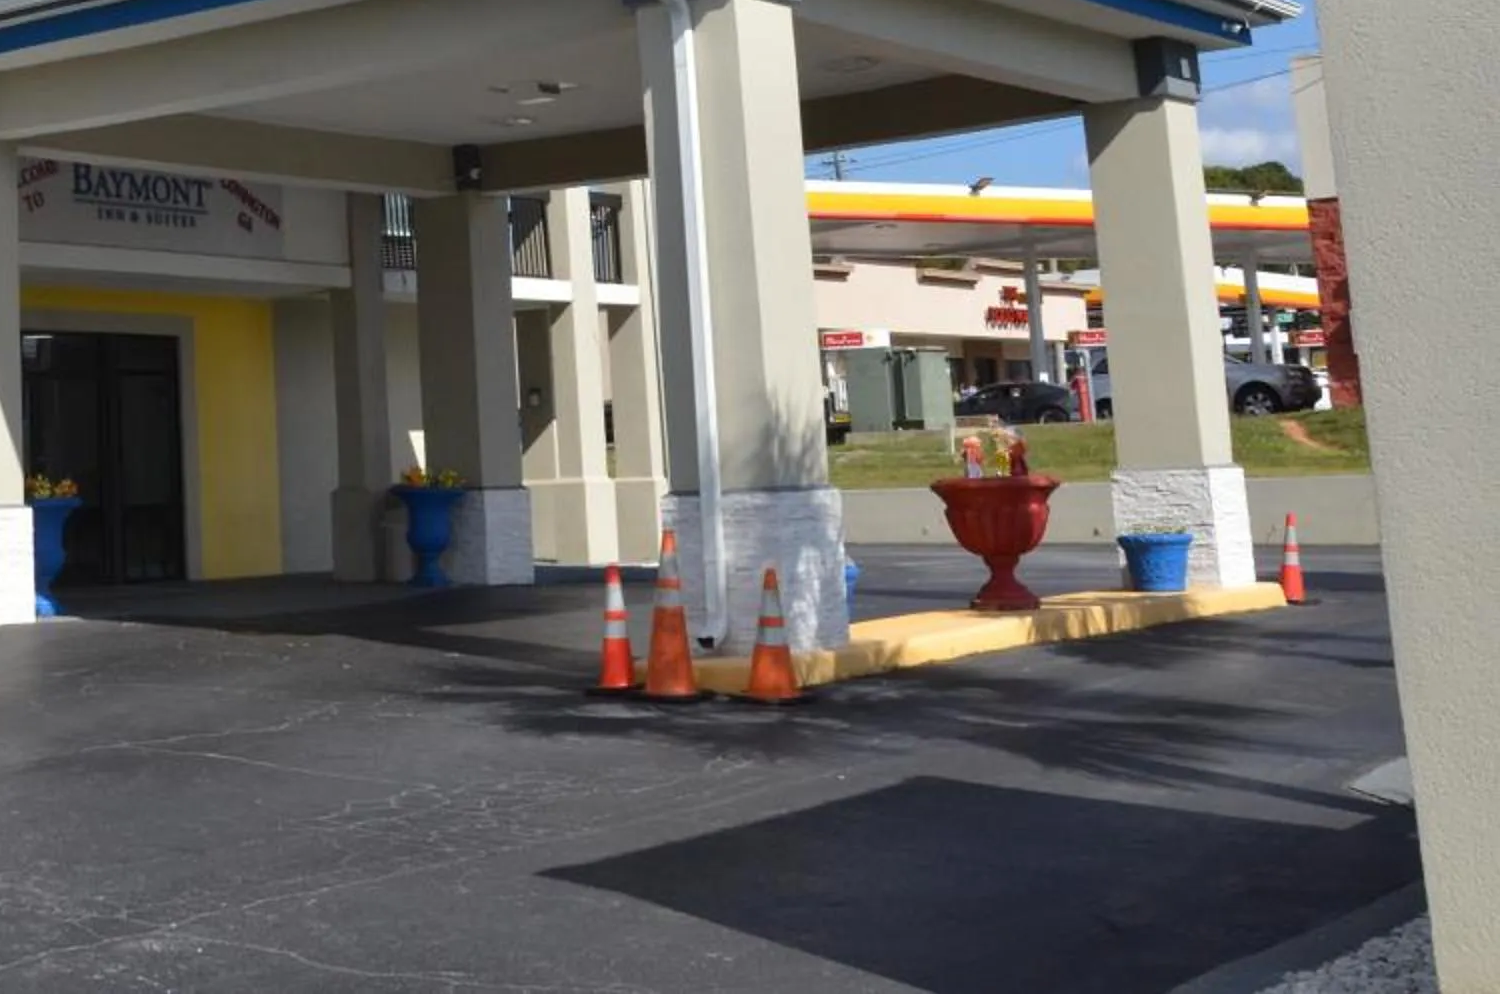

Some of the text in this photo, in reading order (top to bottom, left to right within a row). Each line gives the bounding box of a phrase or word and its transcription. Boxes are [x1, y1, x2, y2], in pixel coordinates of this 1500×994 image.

[72, 162, 210, 208] BAYMONT
[97, 206, 125, 222] INN
[146, 212, 198, 228] SUITES
